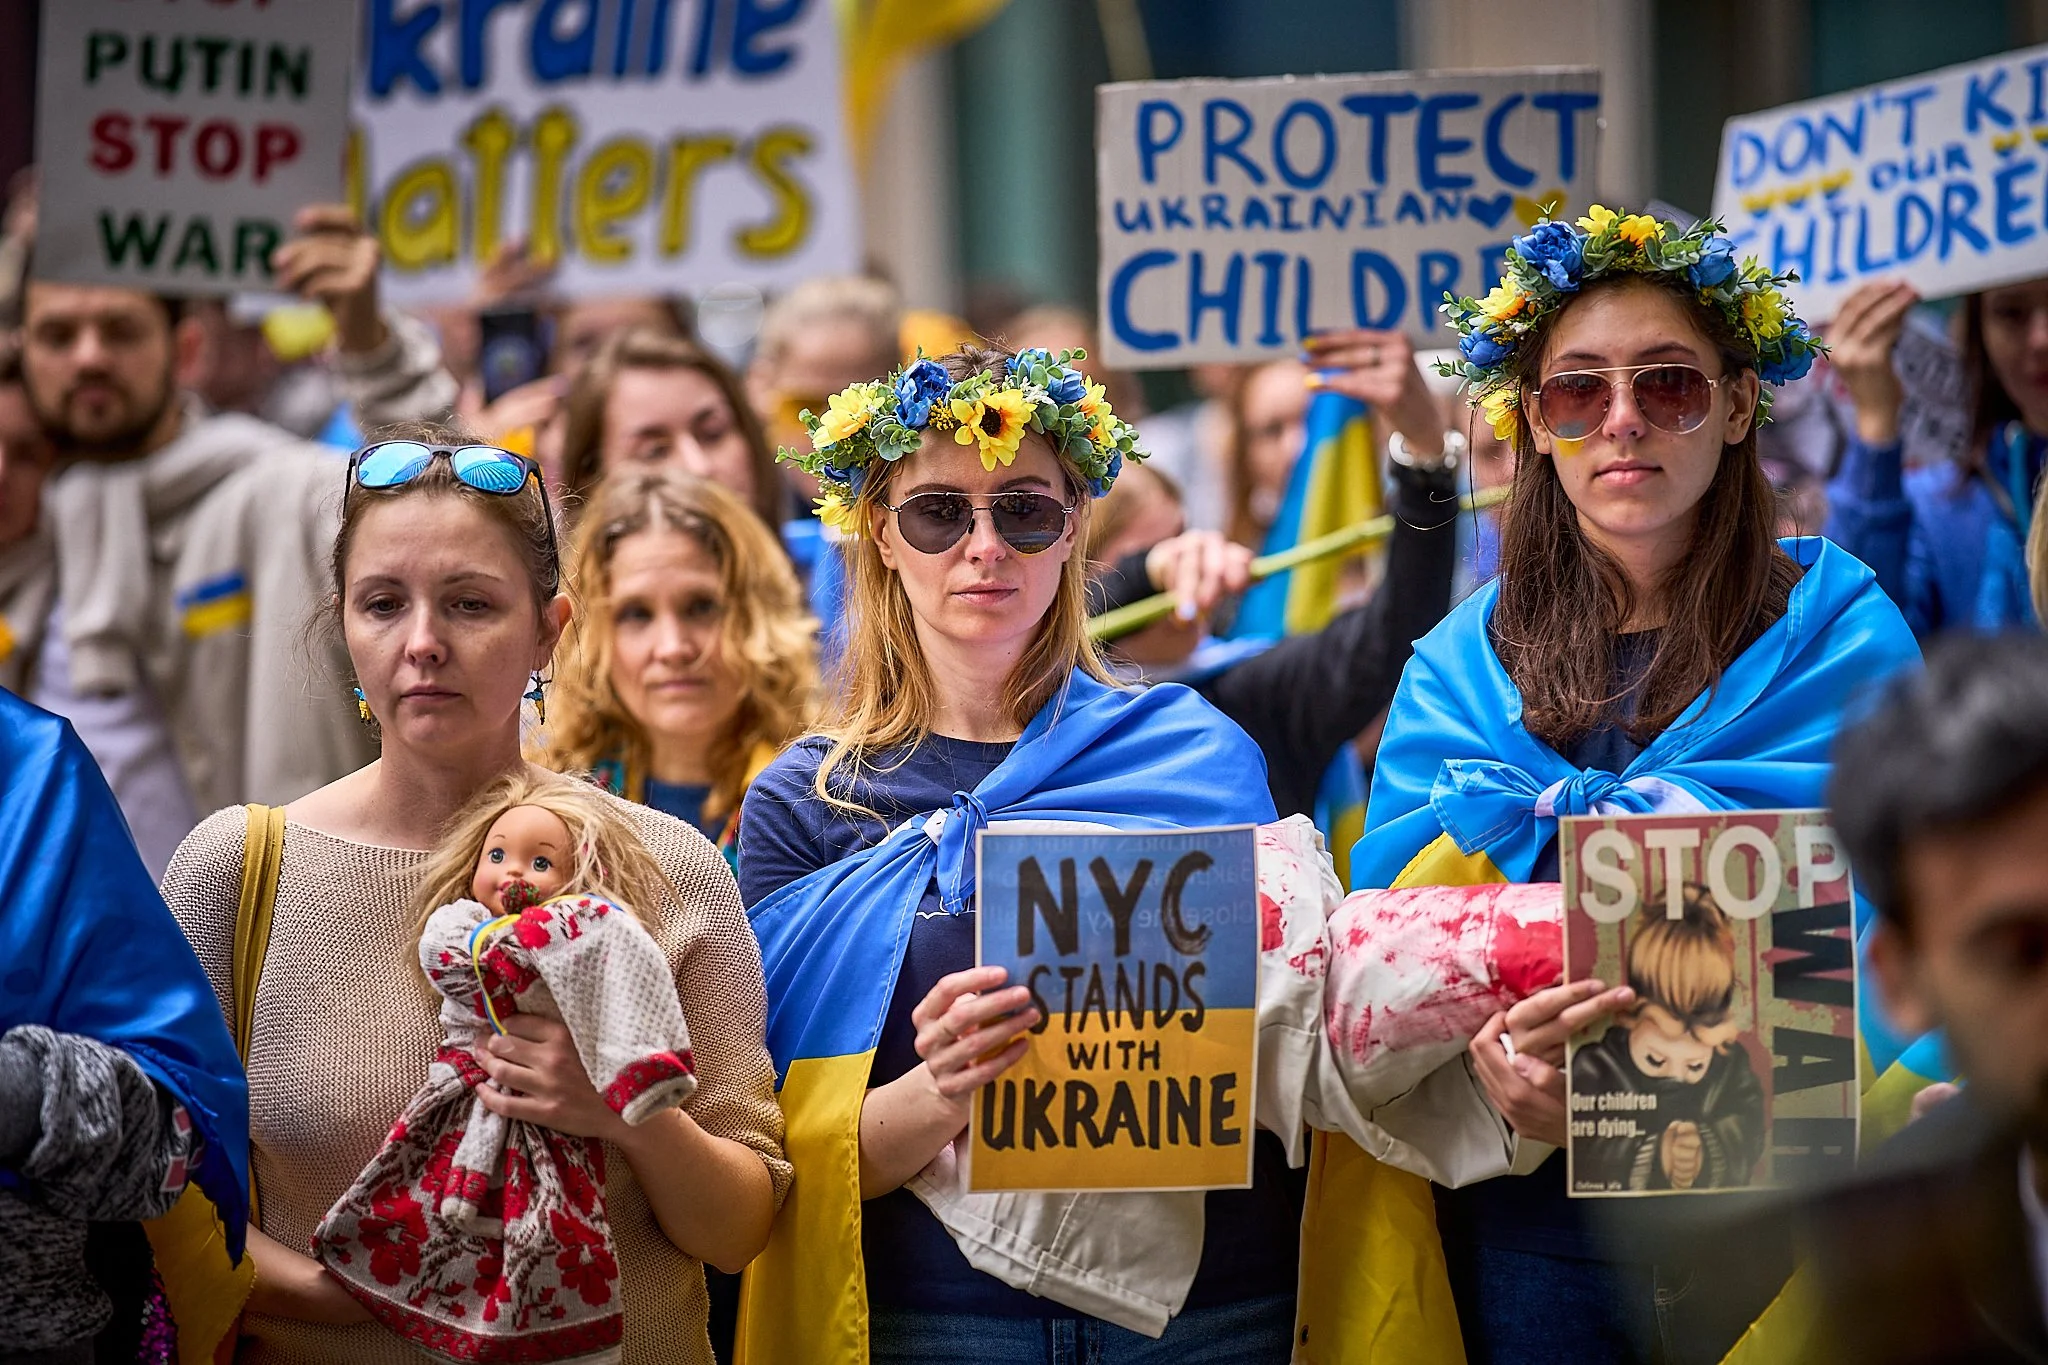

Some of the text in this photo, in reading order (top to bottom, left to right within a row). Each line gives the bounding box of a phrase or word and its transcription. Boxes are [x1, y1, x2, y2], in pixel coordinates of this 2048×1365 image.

[86, 32, 313, 97] PUTIN
[370, 0, 810, 97] kraine
[89, 113, 303, 184] STOP
[1137, 91, 1599, 191] PROTECT
[1730, 84, 1939, 190] DON'T
[346, 106, 816, 268] atters
[1115, 191, 1461, 232] UKRAINIAN
[1724, 160, 2048, 288] HILDRE
[98, 208, 284, 276] WAR
[1108, 244, 1515, 351] CHILDR
[1017, 850, 1214, 958] NYC
[1579, 824, 1851, 924] STOP
[1027, 960, 1206, 1036] STANDS
[1066, 1040, 1161, 1071] WITH
[981, 1072, 1242, 1152] UKRAINE
[1571, 1120, 1595, 1137] are
[1572, 1091, 1657, 1111] Our children
